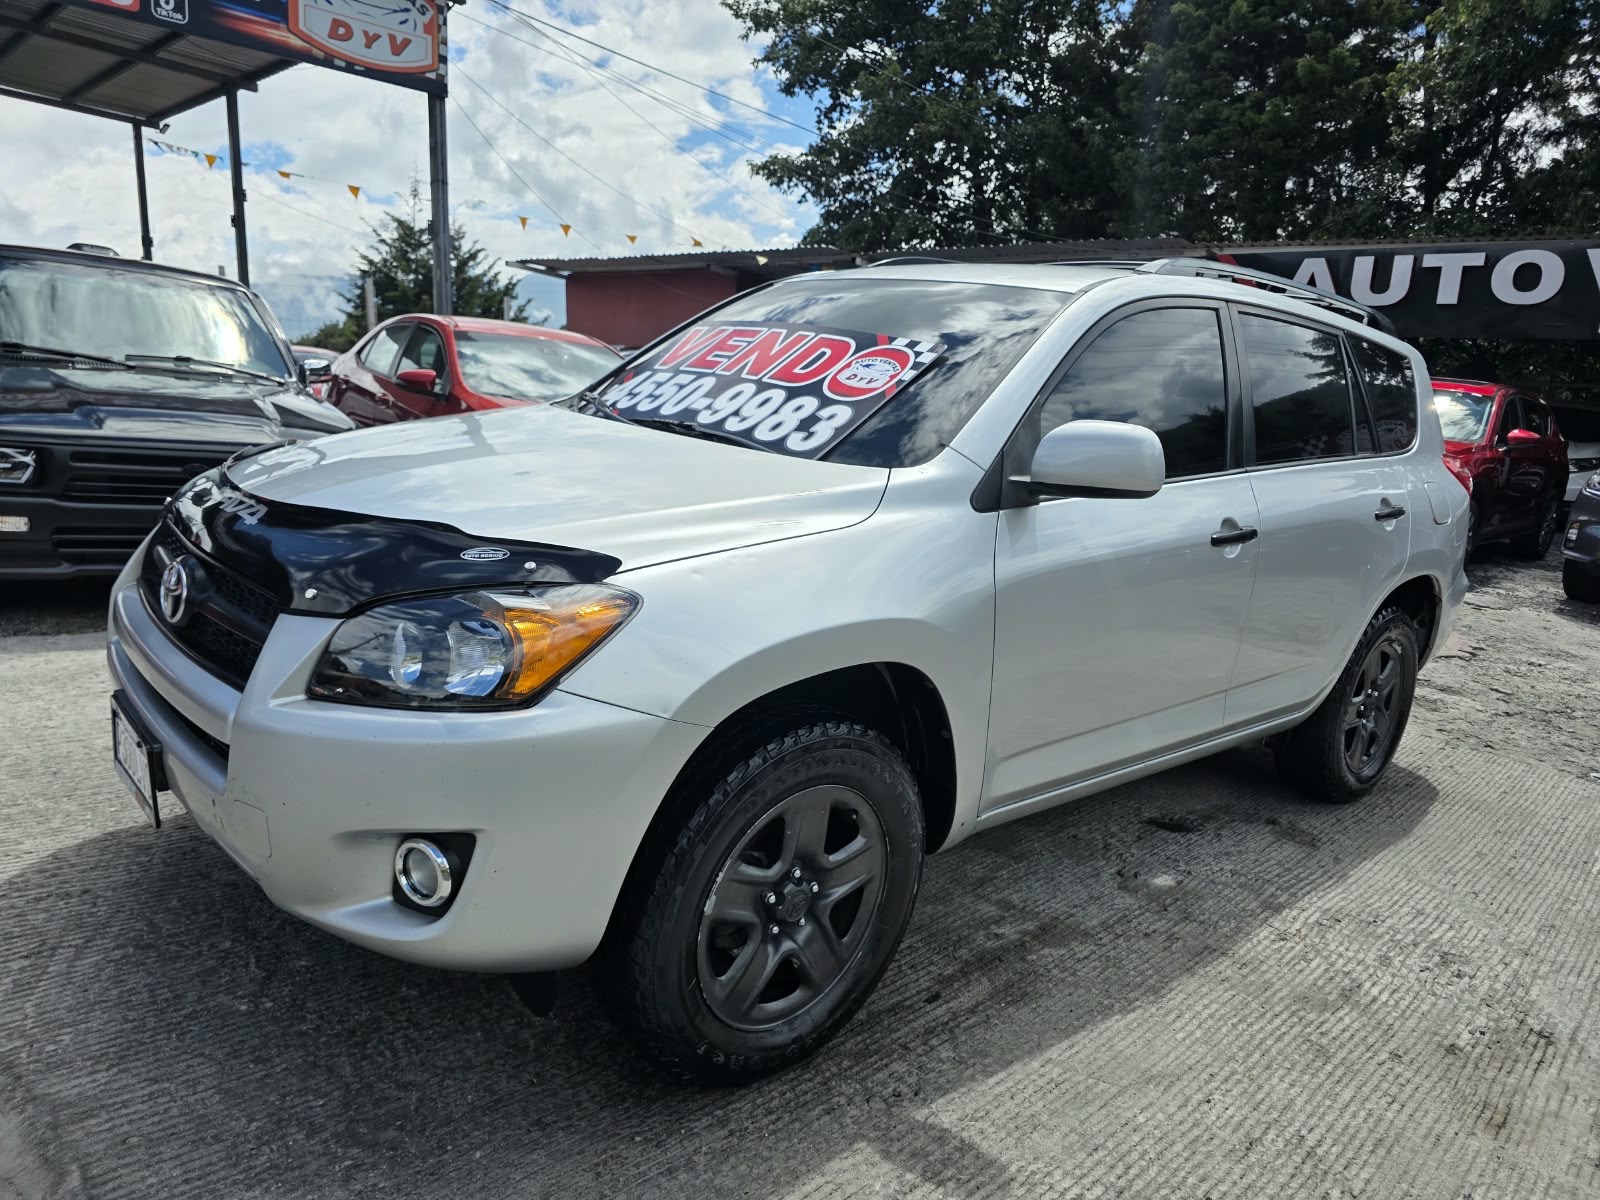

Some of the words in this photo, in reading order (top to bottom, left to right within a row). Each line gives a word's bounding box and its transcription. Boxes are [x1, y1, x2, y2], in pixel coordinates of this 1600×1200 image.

[155, 7, 184, 20] TikTok
[327, 17, 412, 57] DYV
[1284, 249, 1566, 307] AUTO
[845, 372, 880, 385] DYV
[879, 357, 900, 373] VENTAS
[601, 370, 854, 452] 4550-9983
